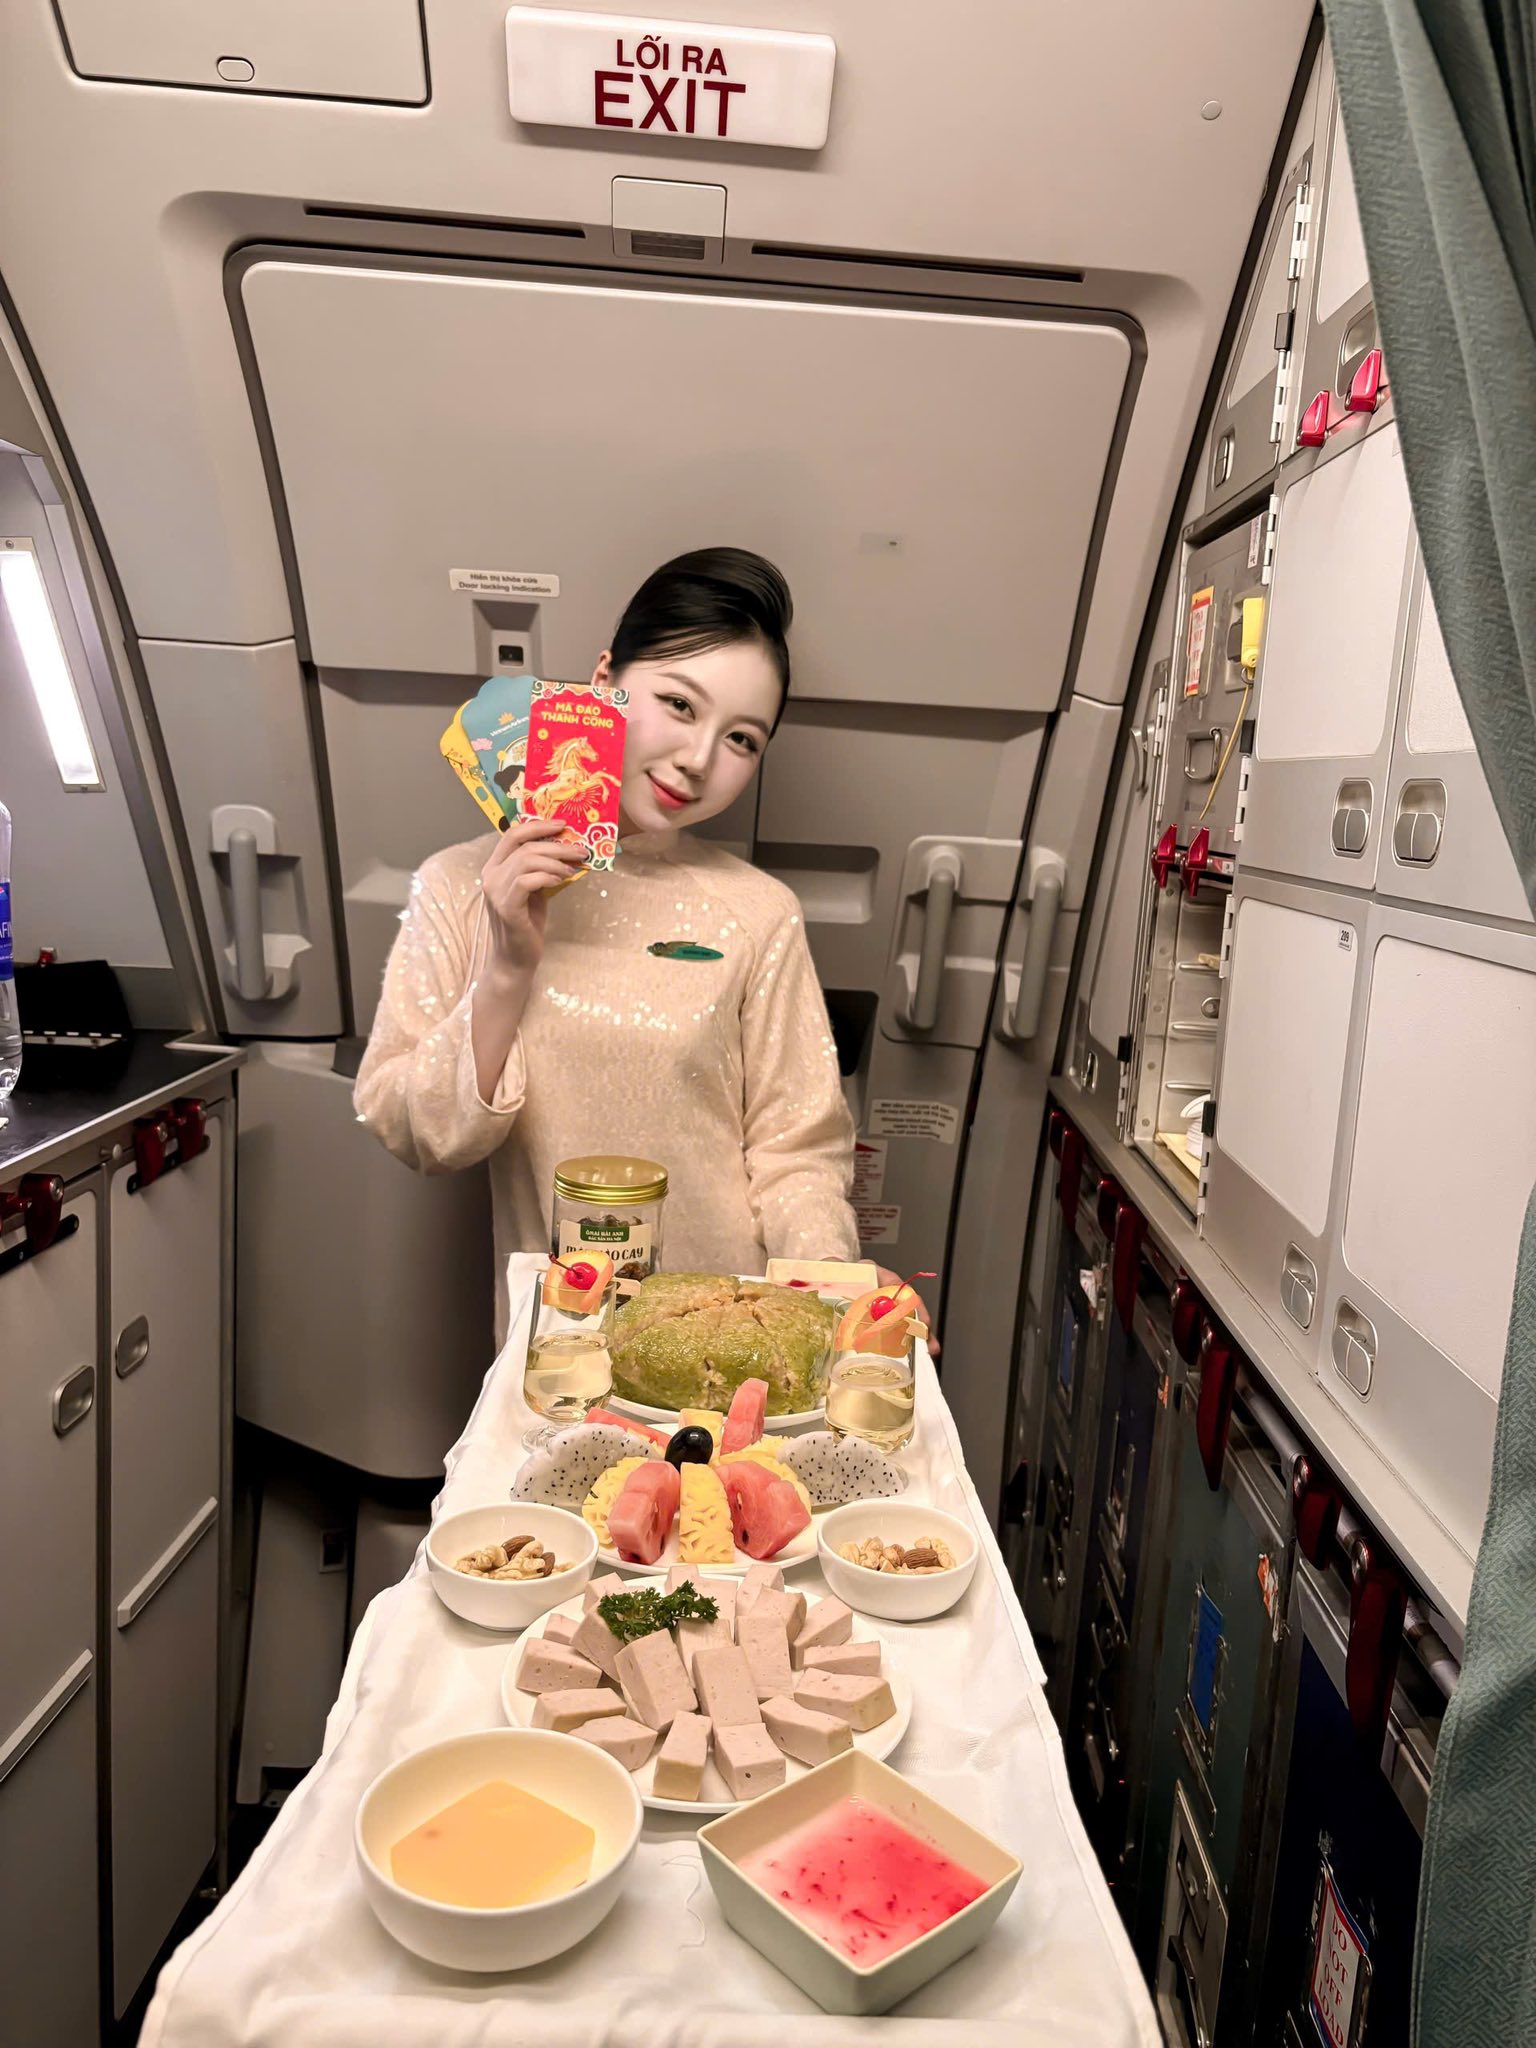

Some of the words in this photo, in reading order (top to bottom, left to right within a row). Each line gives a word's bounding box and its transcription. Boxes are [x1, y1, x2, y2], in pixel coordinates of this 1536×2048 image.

[616, 34, 670, 71] LỐI
[682, 45, 728, 76] RA
[594, 70, 746, 137] EXIT
[458, 581, 478, 589] Door
[480, 583, 510, 592] locking
[622, 1247, 644, 1260] CAY
[1332, 1914, 1348, 1951] DO
[1328, 1934, 1349, 1985] NOT
[1324, 1963, 1343, 2007] OFF
[1318, 1981, 1344, 2046] LOAD
